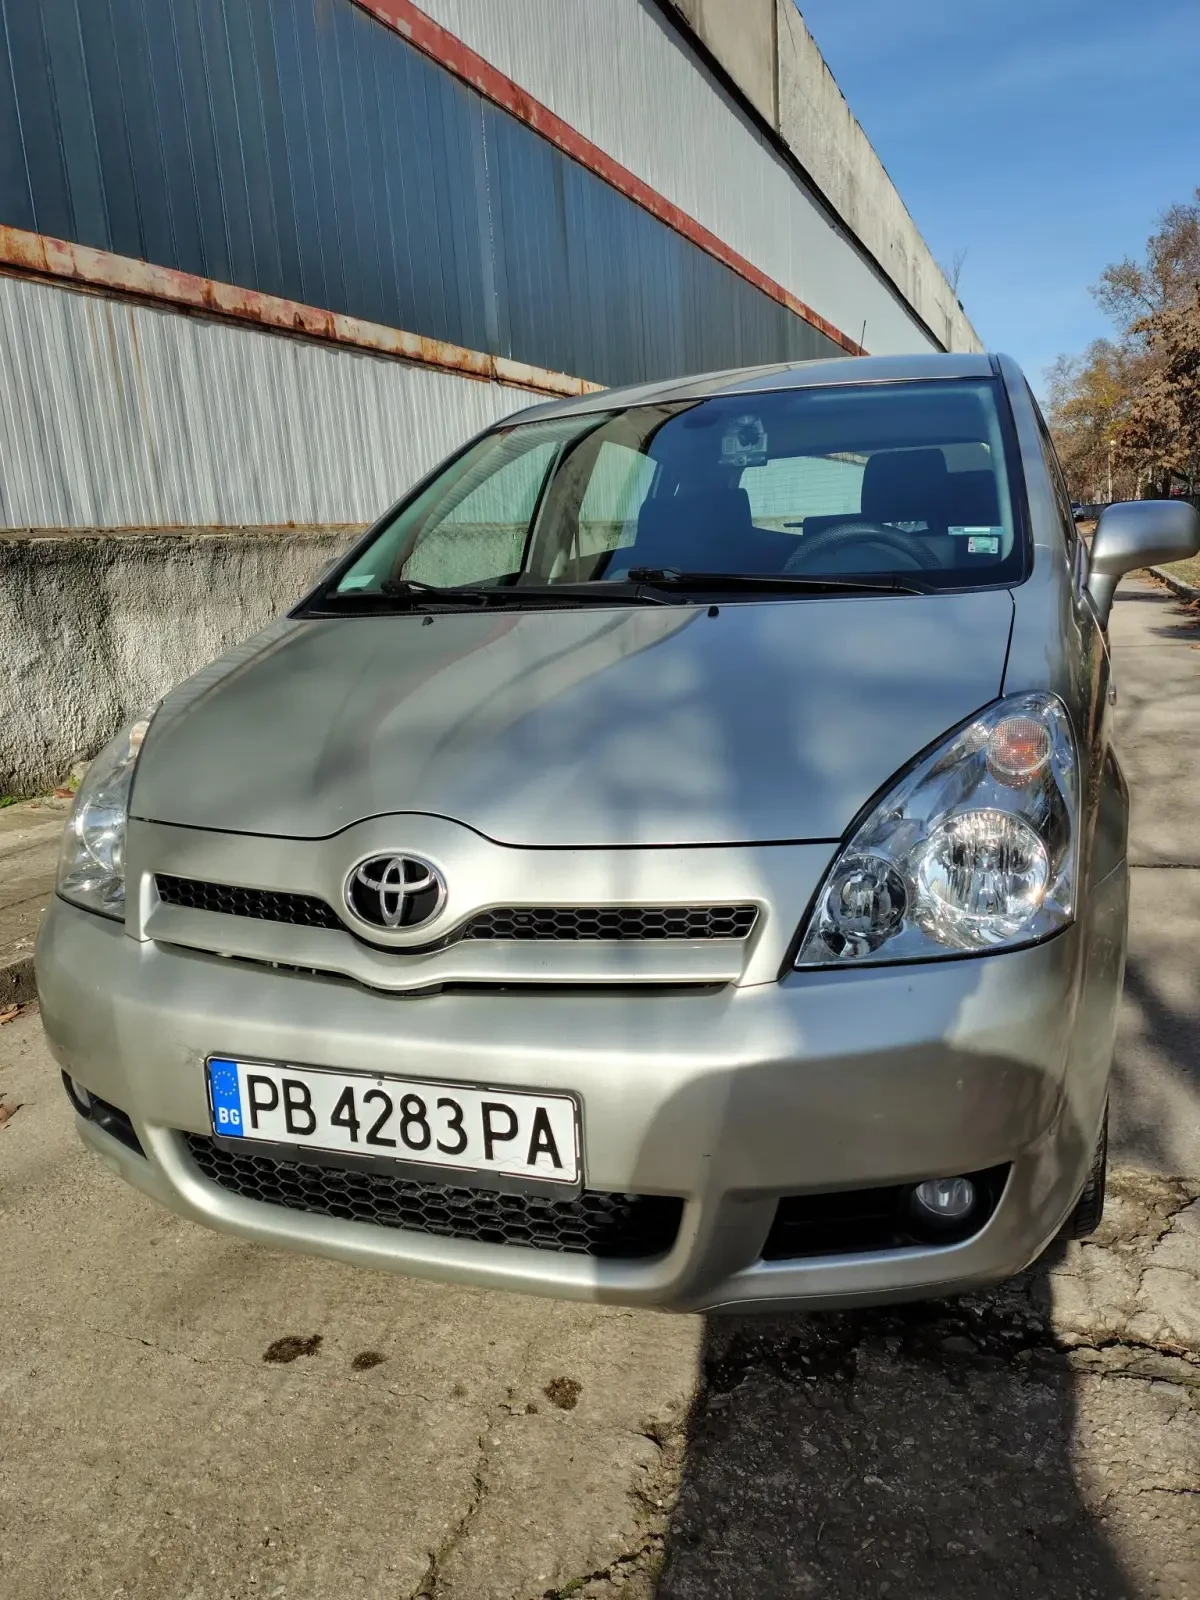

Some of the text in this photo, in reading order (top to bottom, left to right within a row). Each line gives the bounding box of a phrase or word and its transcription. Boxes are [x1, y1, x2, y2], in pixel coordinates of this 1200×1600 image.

[218, 1107, 240, 1125] BG
[246, 1074, 563, 1169] PB 4283 PA
